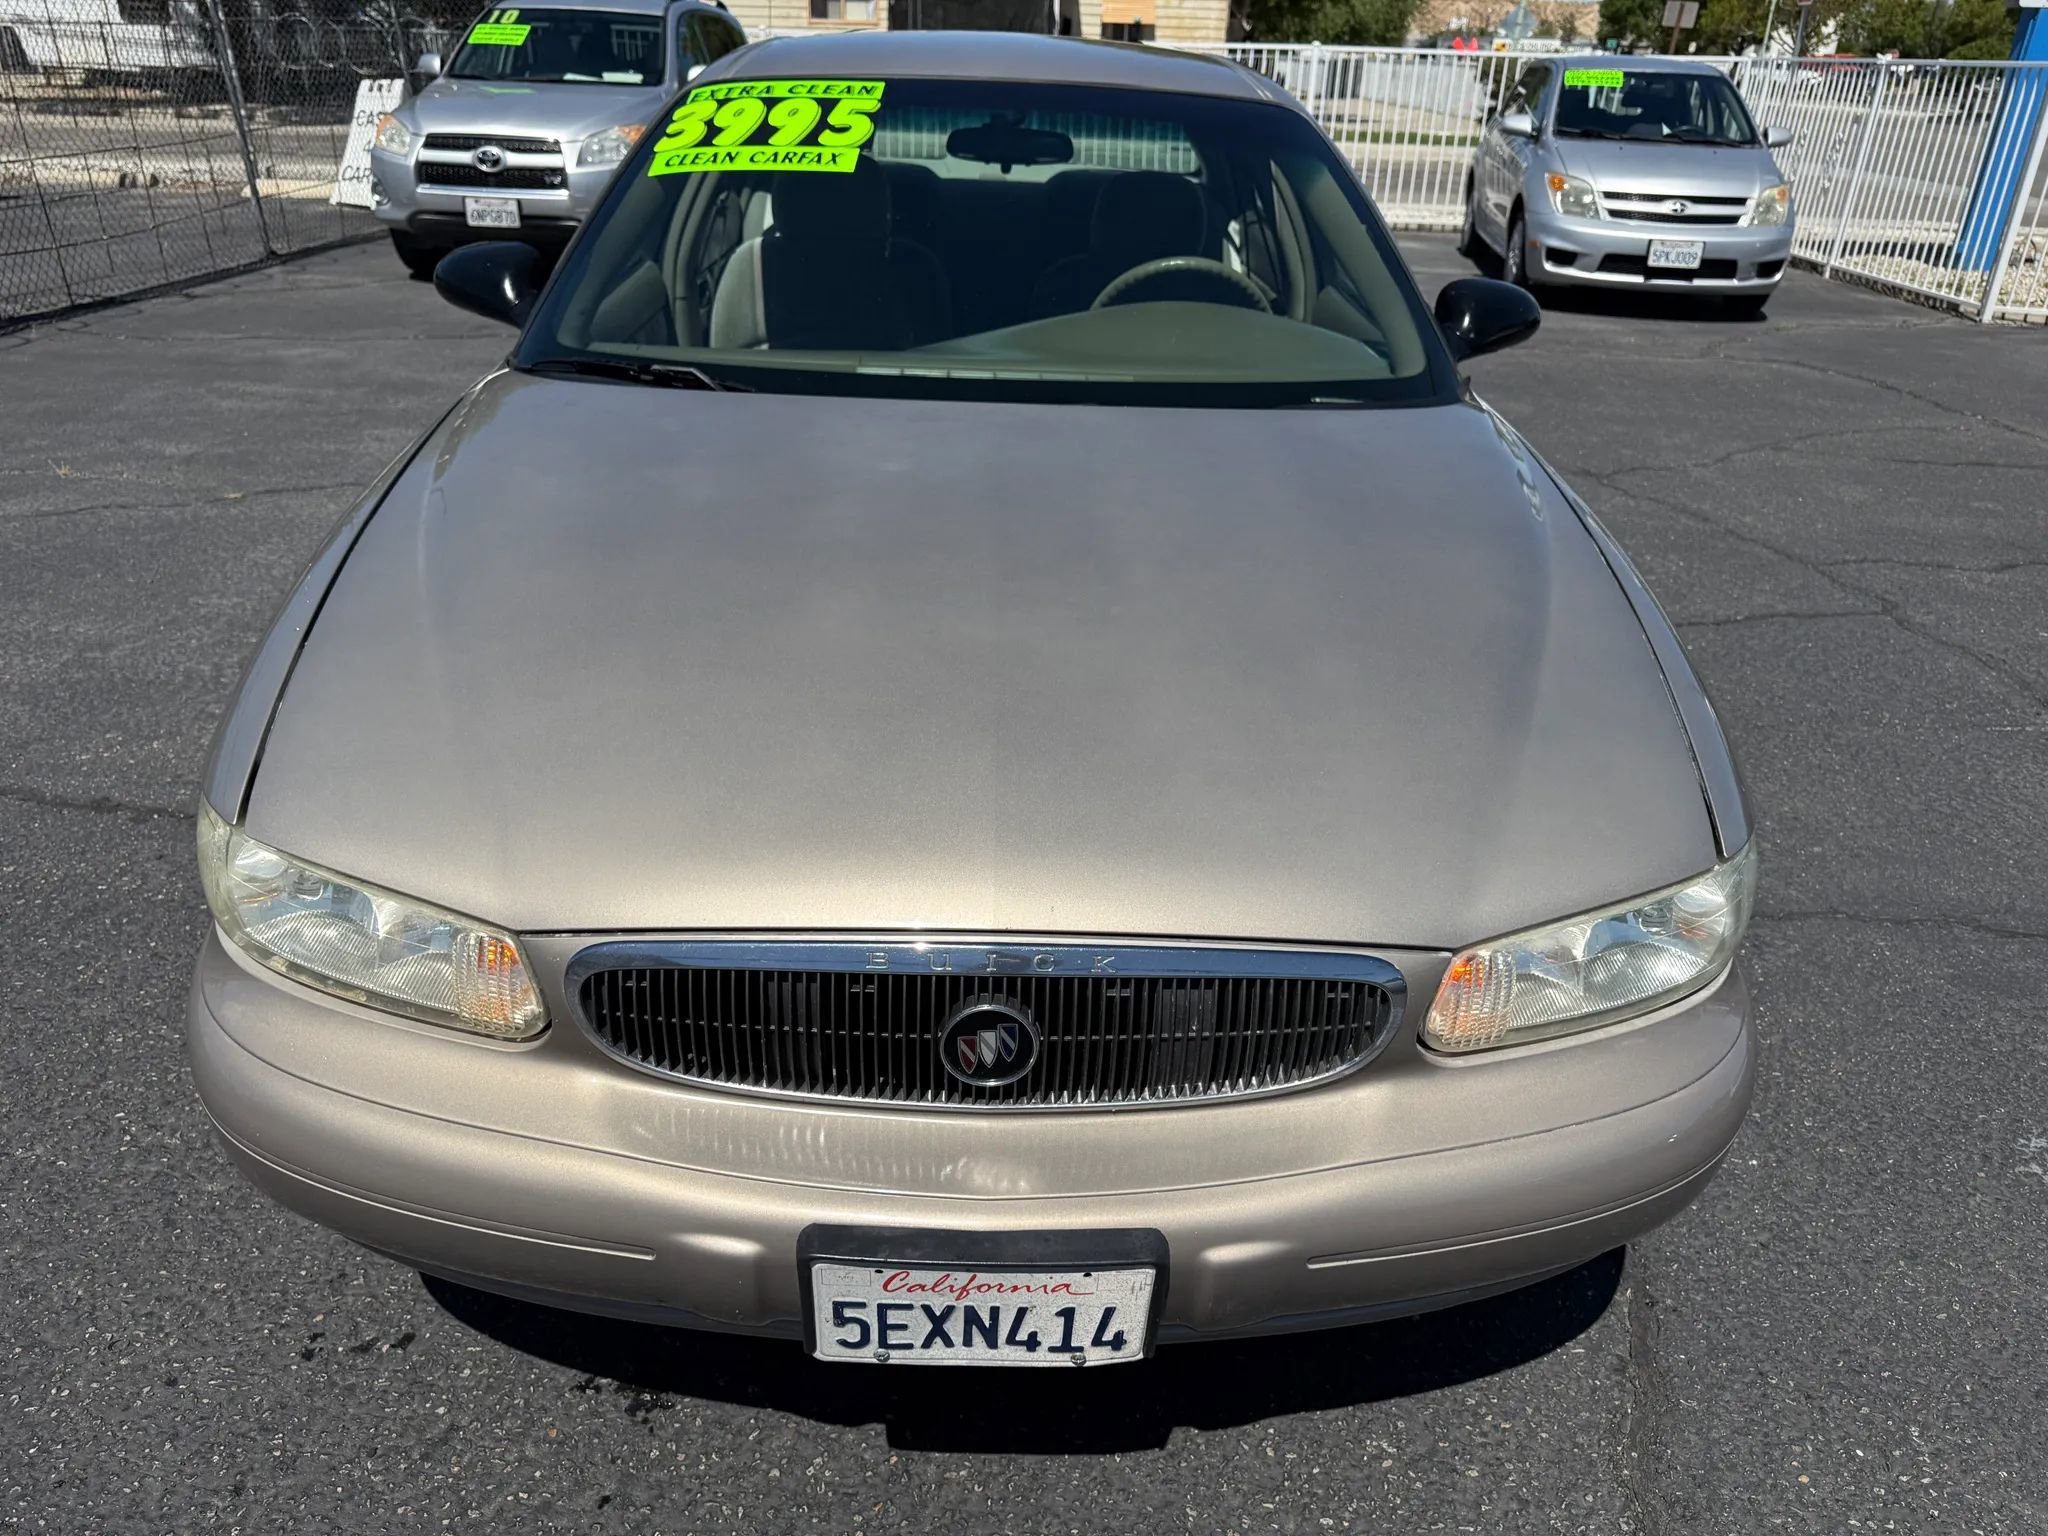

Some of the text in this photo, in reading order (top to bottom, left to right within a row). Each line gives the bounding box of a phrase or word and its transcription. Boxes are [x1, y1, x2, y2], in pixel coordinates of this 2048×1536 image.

[488, 9, 520, 24] 10
[689, 83, 879, 103] EXTRA CLEAN
[653, 97, 882, 153] 3995
[663, 151, 844, 168] CLEAN CARFAX
[865, 952, 1116, 973] BUICK
[882, 1270, 1094, 1302] California
[831, 1301, 1128, 1353] 5EXN414
